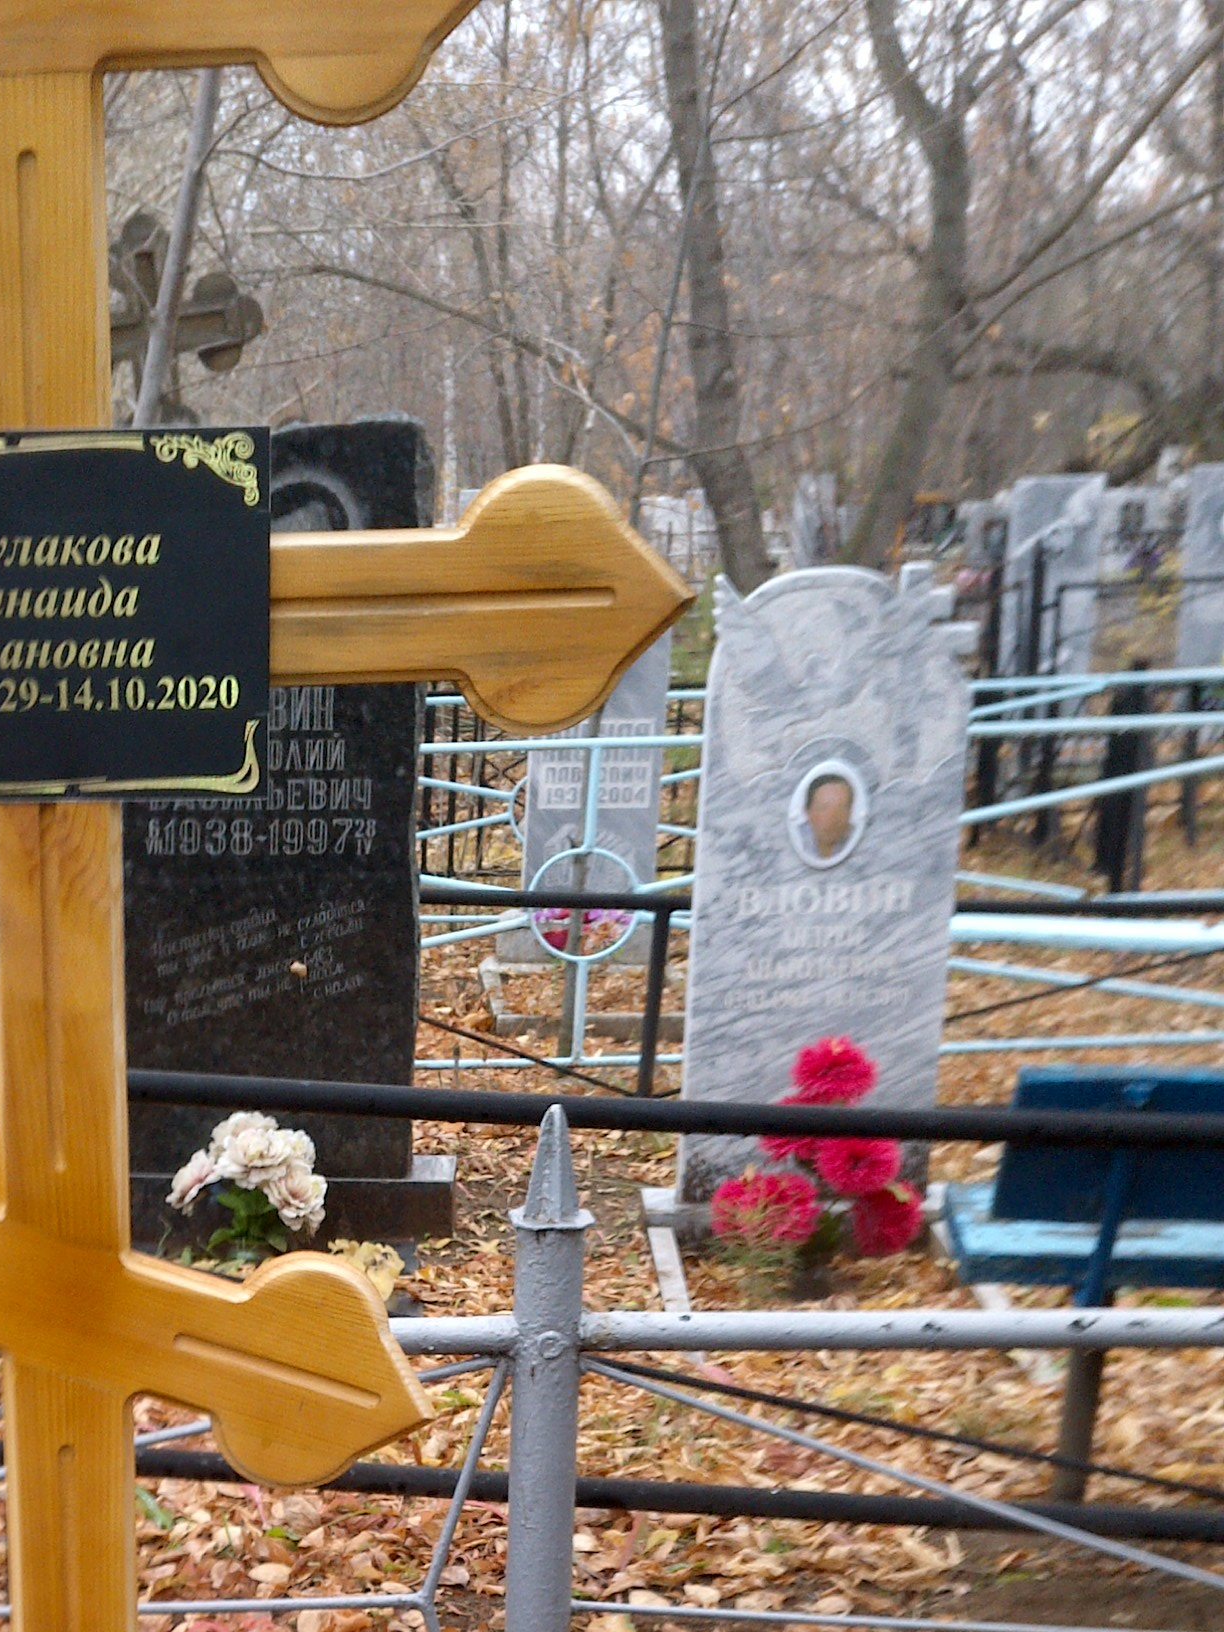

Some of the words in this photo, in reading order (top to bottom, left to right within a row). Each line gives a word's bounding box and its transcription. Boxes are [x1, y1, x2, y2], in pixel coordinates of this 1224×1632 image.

[267, 686, 336, 731] ВИН
[268, 732, 346, 771] ОЛИЙ
[544, 765, 647, 784] ПАВОВИЧ
[163, 818, 353, 856] 1938-1997
